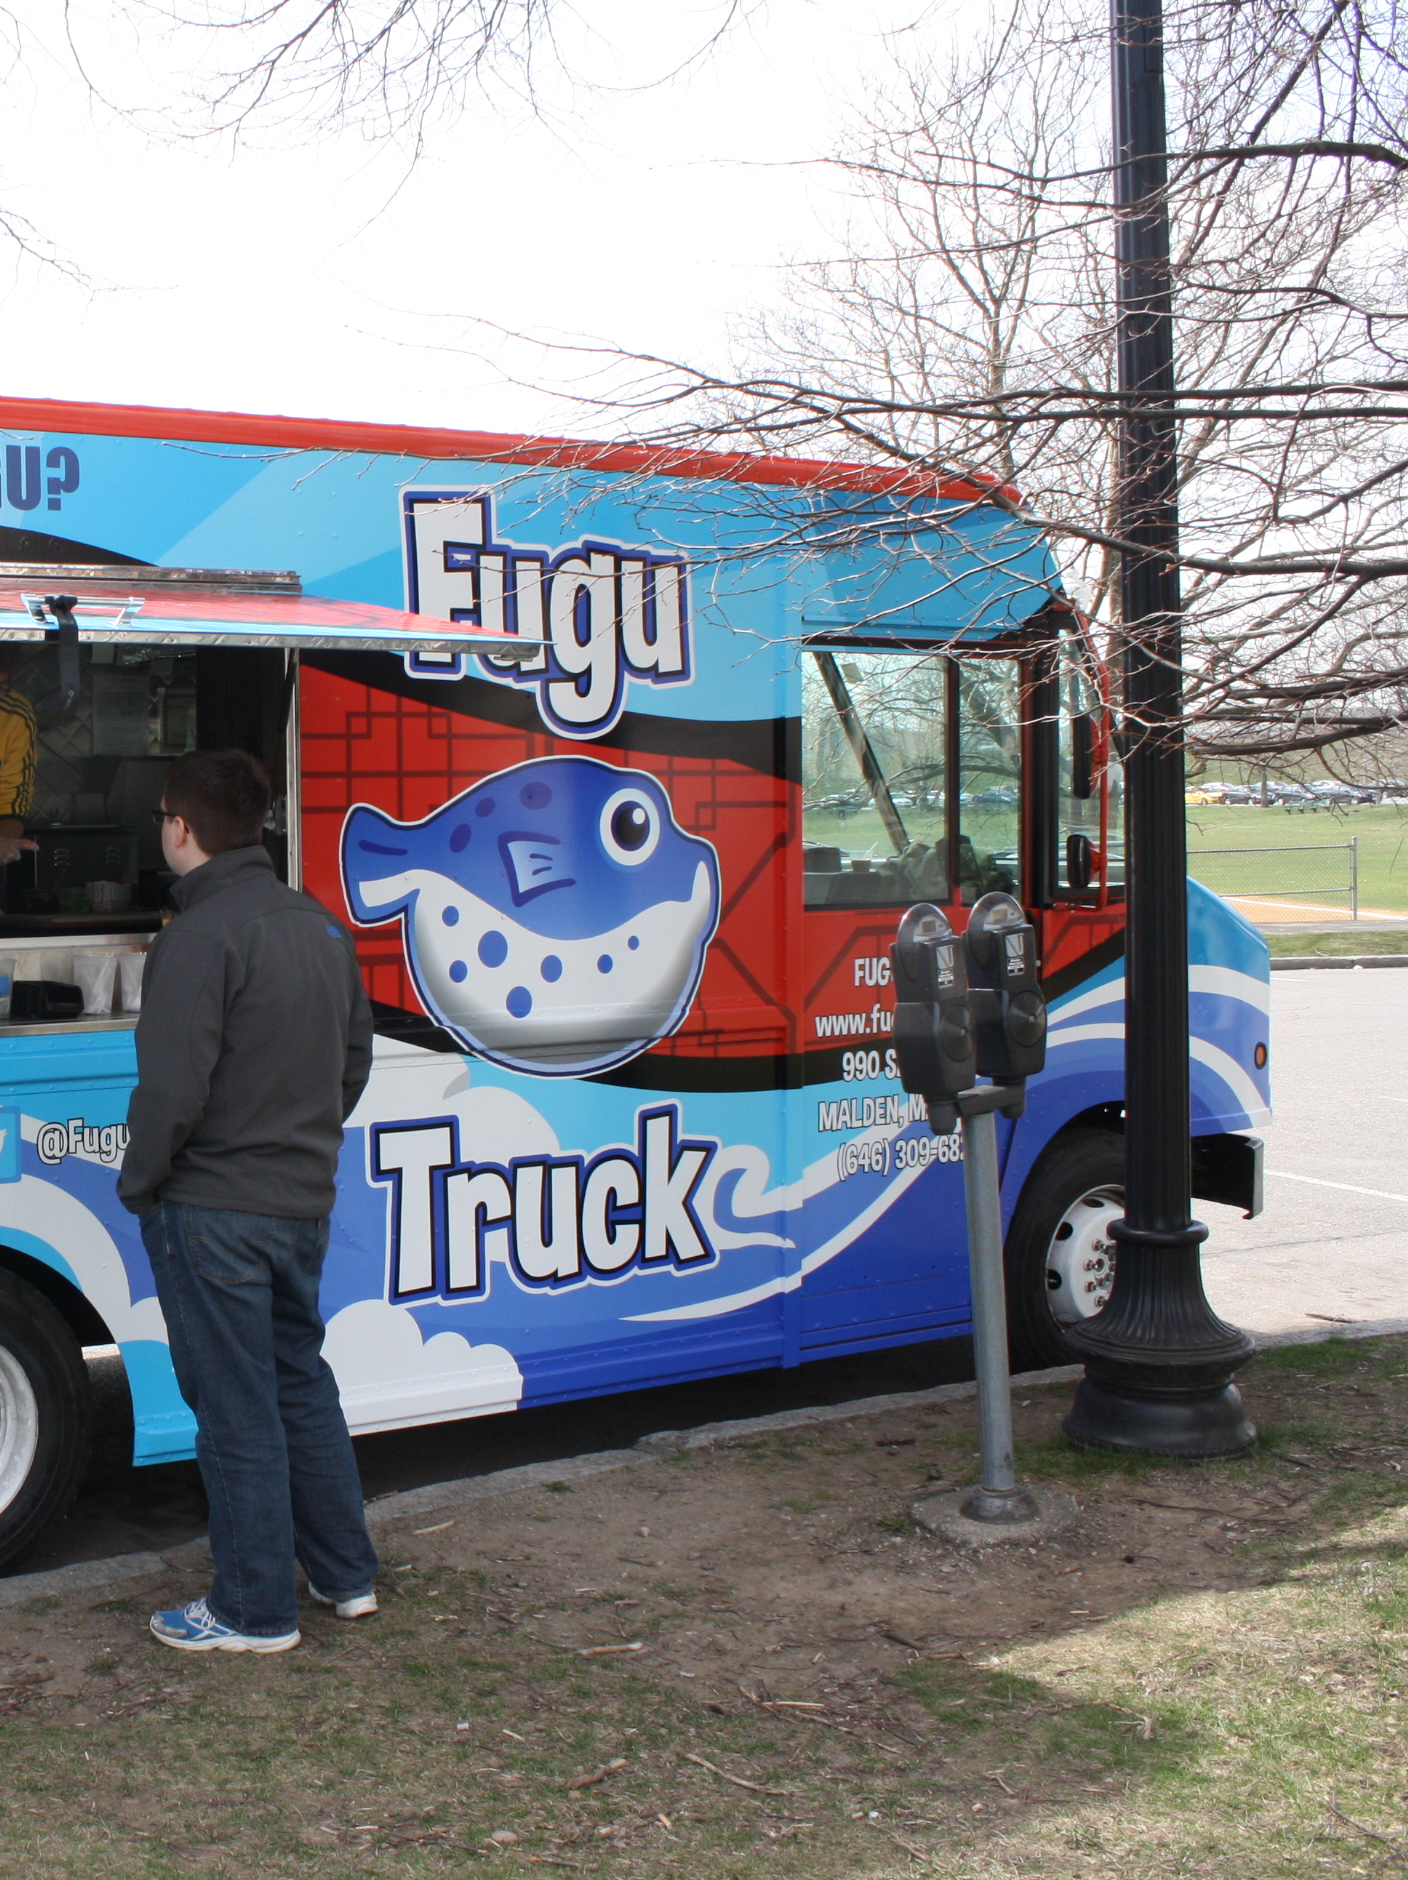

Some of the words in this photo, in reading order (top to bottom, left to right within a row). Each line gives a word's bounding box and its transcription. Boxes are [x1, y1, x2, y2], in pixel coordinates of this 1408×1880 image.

[405, 491, 691, 731] Fugu
[853, 956, 894, 987] FUG
[814, 1002, 895, 1038] www.fu
[842, 1050, 880, 1082] 990
[884, 1048, 902, 1080] S
[818, 1094, 904, 1132] MALDEN,
[908, 1093, 928, 1122] M
[837, 1138, 891, 1181] (646)
[894, 1134, 964, 1169] 309-68
[374, 1110, 719, 1296] Truck
